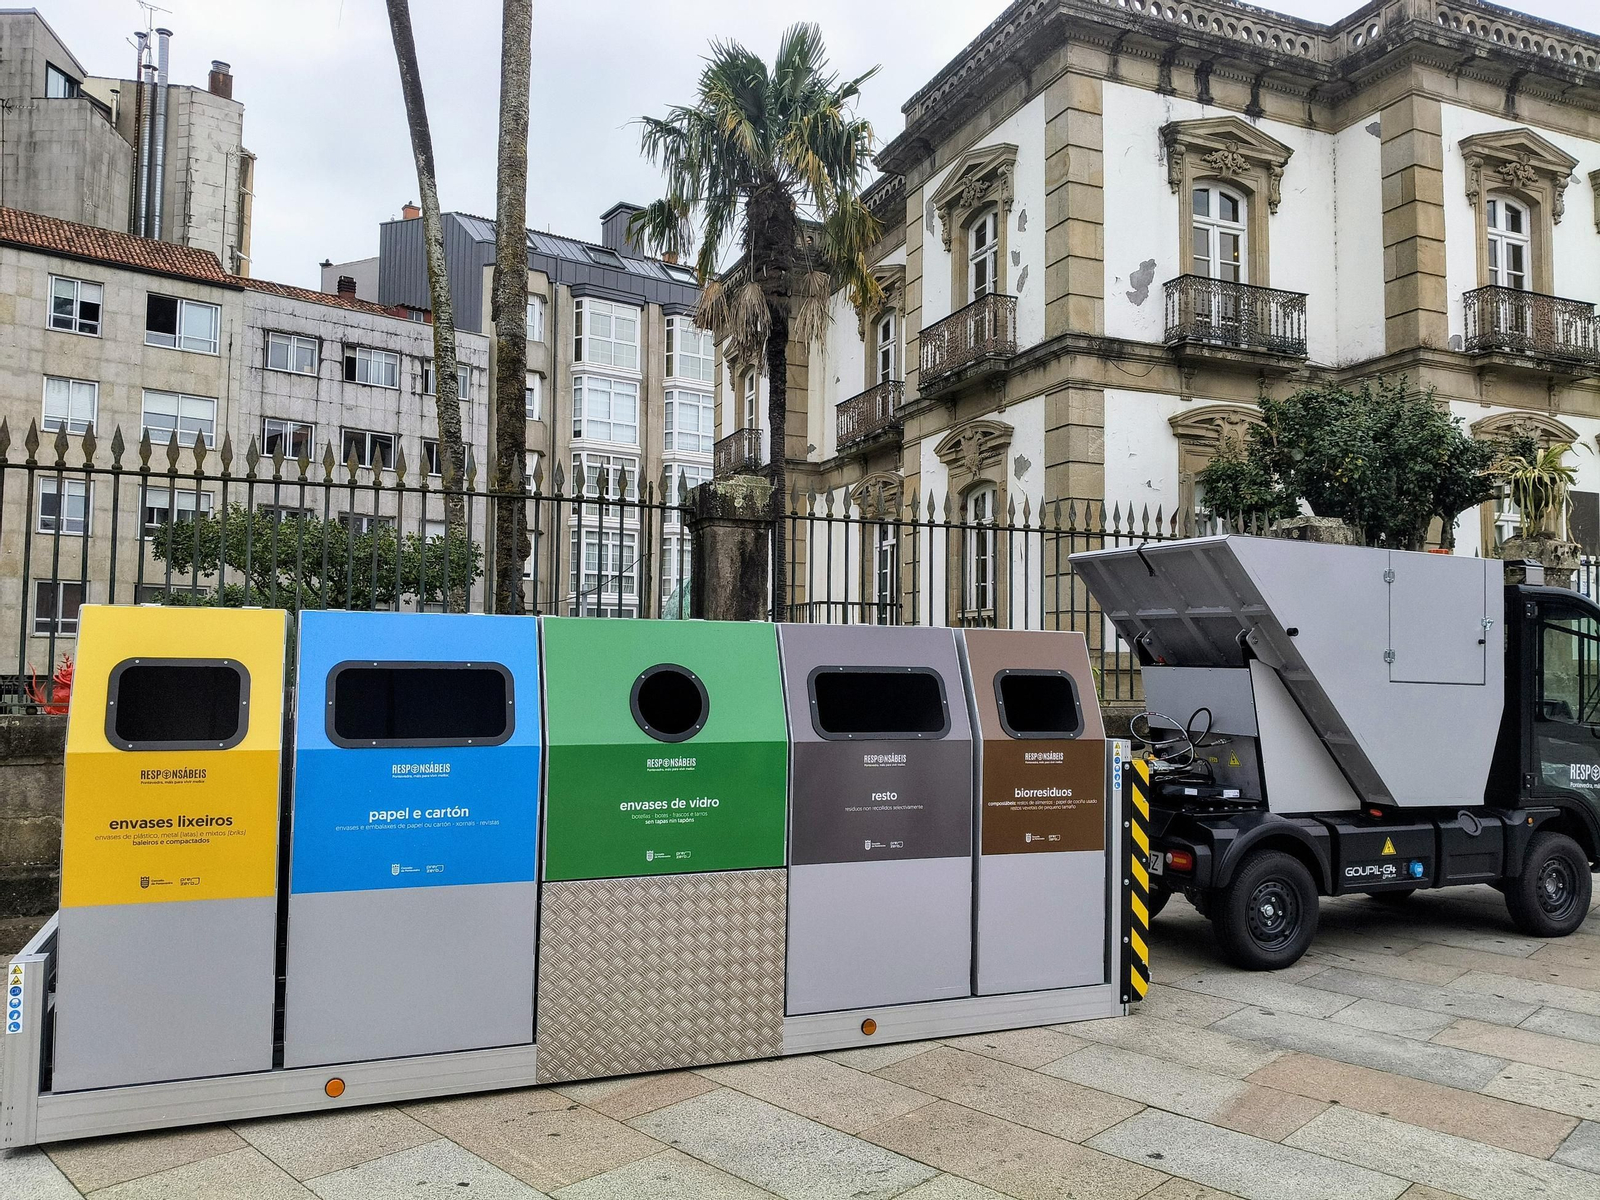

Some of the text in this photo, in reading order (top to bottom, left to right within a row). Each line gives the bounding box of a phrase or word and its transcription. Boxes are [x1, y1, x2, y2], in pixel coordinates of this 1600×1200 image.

[864, 752, 906, 763] RESPONSÁBEIS
[1024, 751, 1064, 760] RESPONSÁBEIS
[392, 761, 450, 774] RESPONSÁBEIS
[646, 756, 696, 768] RESPONSÁBEIS
[141, 766, 207, 780] RESPONSÁBEIS
[871, 791, 898, 801] resto
[1014, 788, 1072, 798] biorresiduos
[620, 796, 720, 811] envases de vidro
[369, 805, 469, 822] papel e cartón
[109, 815, 233, 830] envases lixeiros
[134, 832, 160, 840] plástico,
